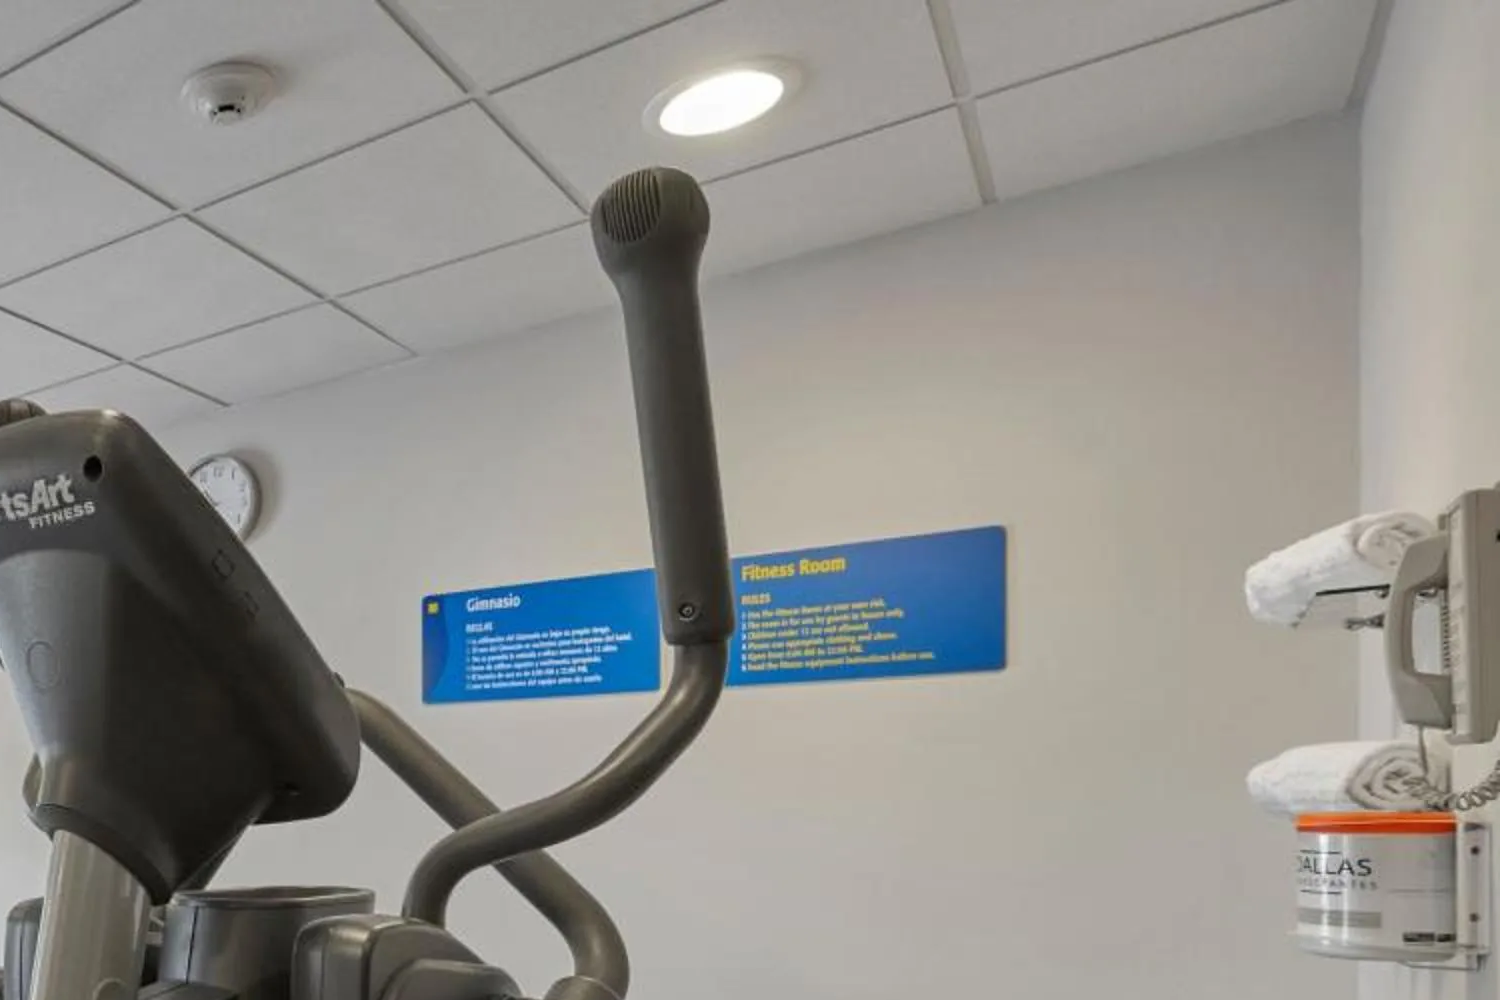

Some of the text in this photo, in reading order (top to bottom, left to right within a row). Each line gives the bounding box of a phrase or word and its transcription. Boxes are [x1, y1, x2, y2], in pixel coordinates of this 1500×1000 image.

[29, 501, 96, 529] FITNESS
[741, 557, 846, 581] Fitness Room
[466, 593, 521, 613] Gimnasio
